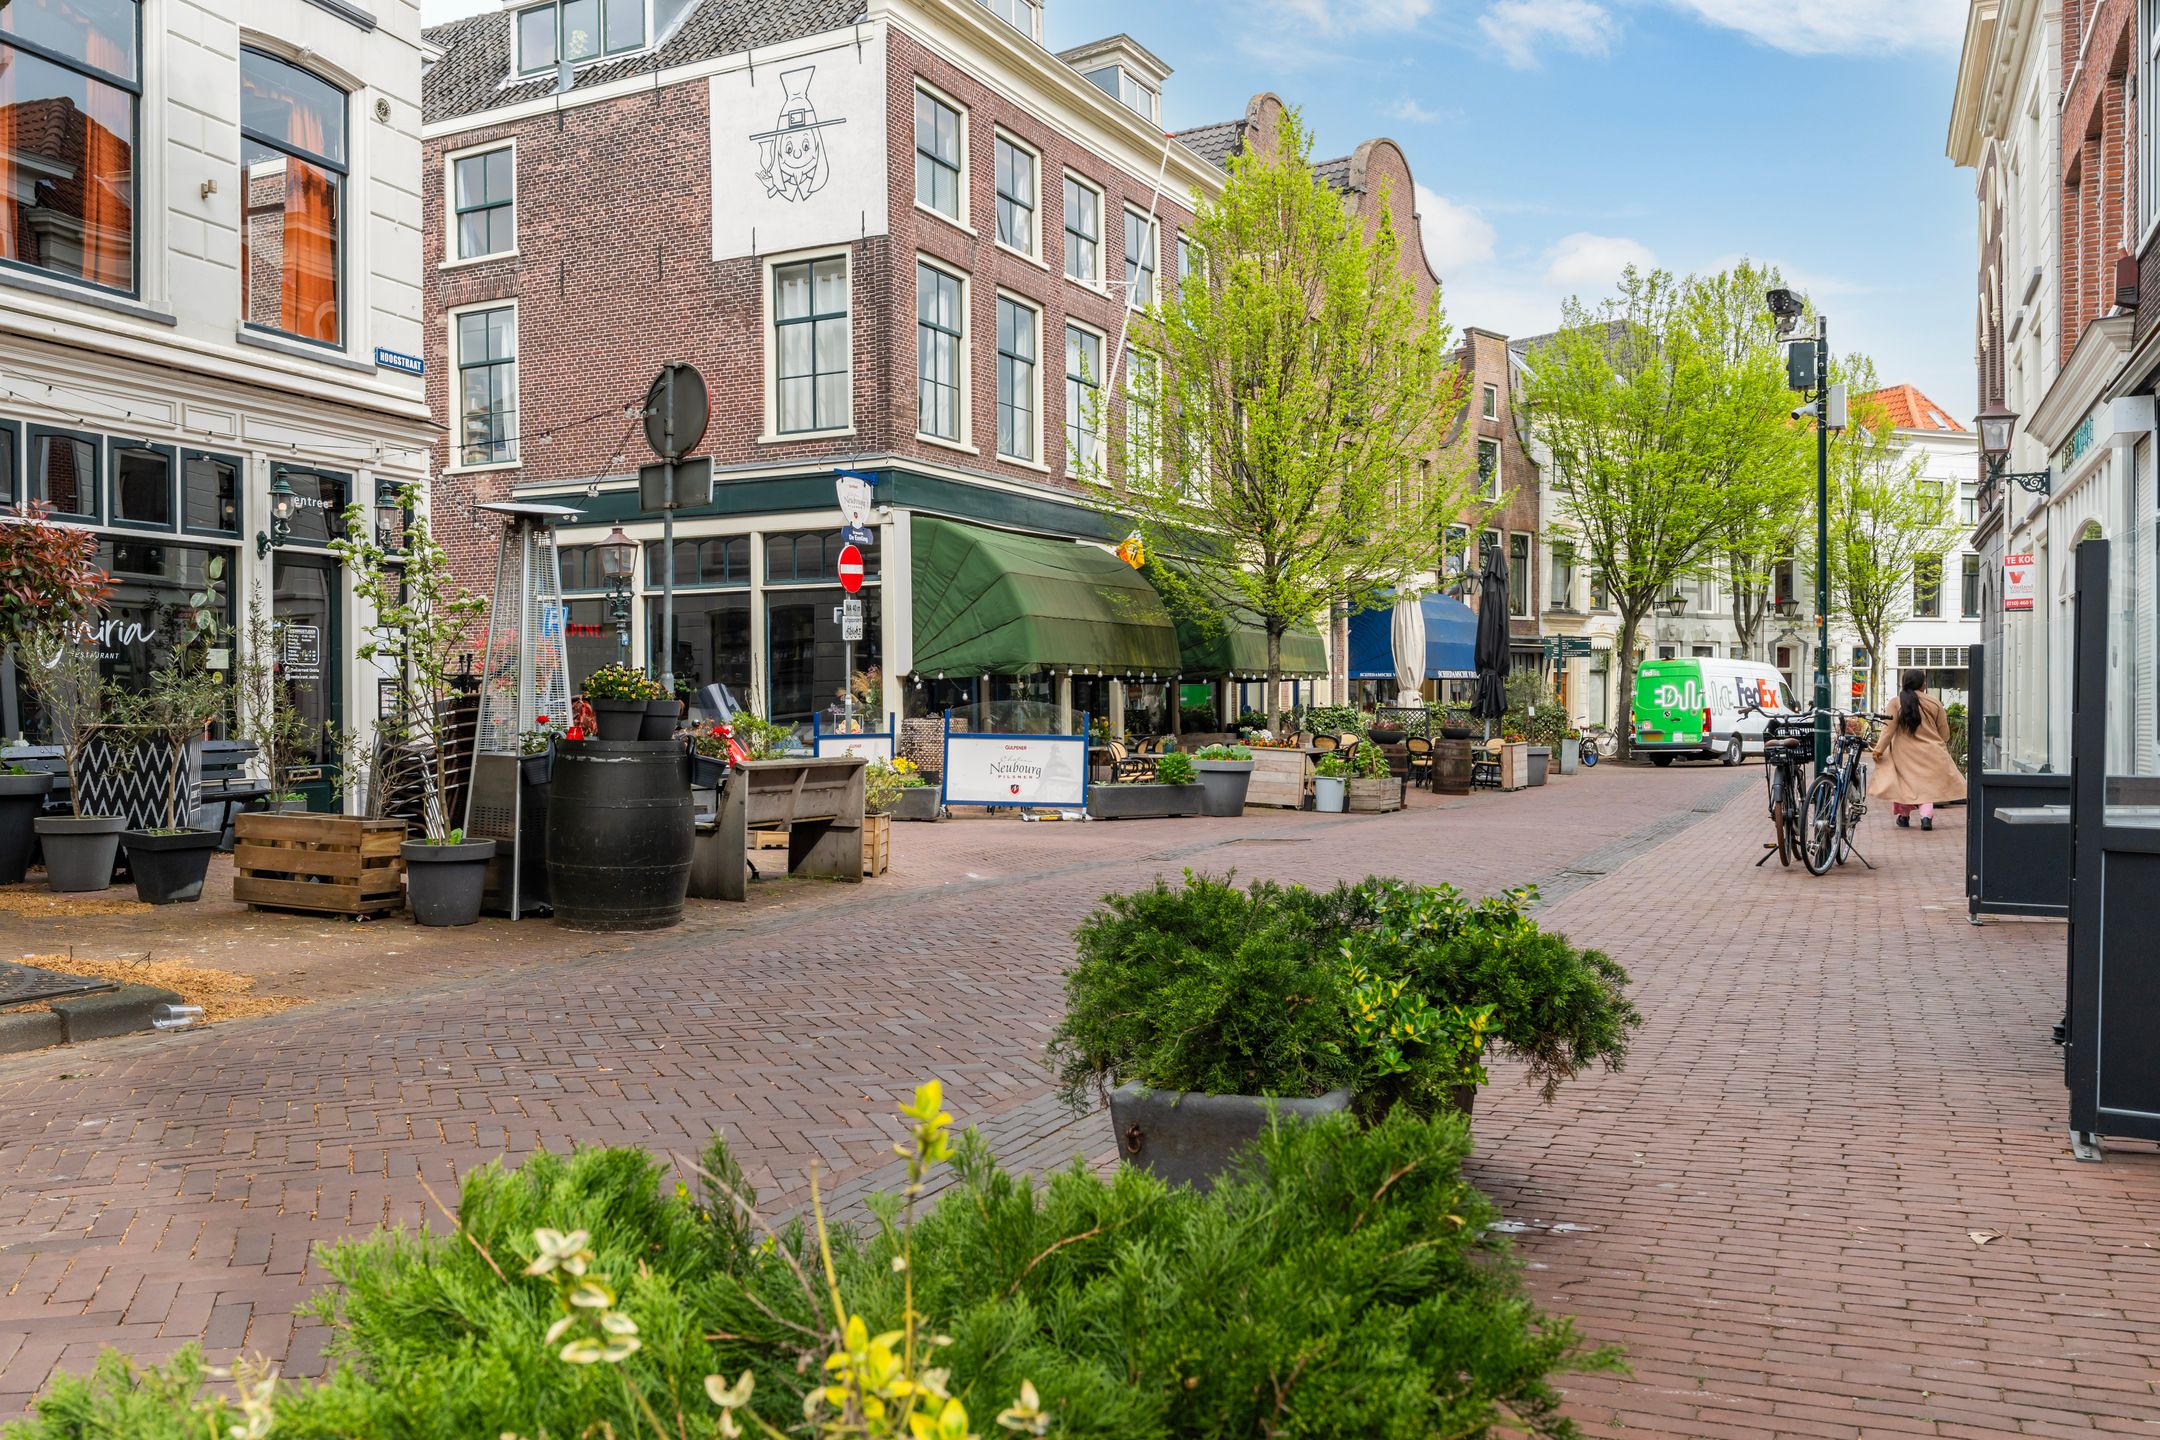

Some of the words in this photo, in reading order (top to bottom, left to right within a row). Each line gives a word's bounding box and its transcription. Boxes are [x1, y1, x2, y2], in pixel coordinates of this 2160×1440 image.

[380, 351, 421, 371] HOOGSTRAAT
[294, 496, 329, 509] entree
[1735, 676, 1779, 709] FedEx
[989, 761, 1042, 779] Neubourg
